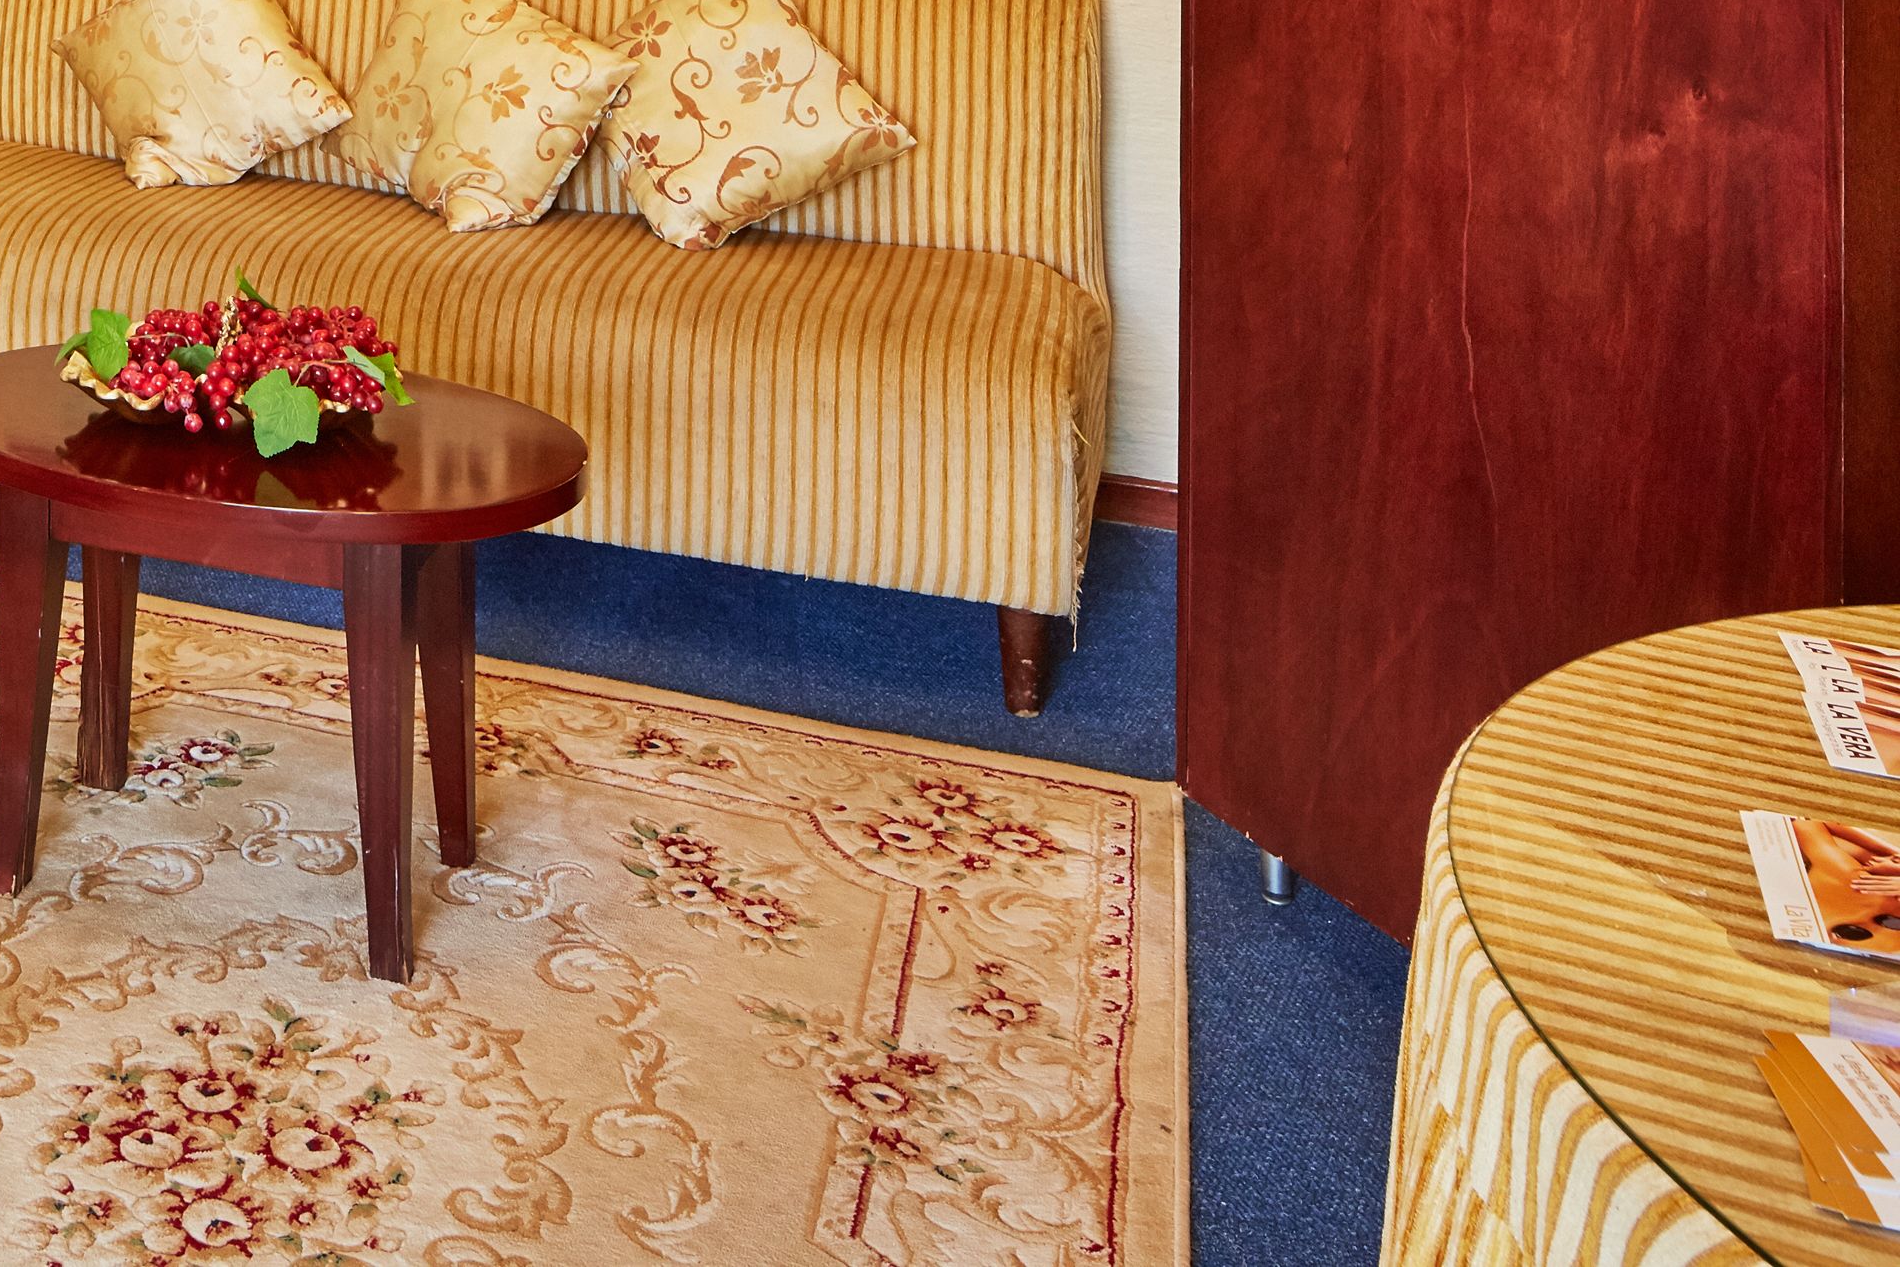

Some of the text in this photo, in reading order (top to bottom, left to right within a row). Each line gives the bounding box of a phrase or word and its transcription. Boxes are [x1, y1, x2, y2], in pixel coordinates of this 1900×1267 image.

[1831, 678, 1860, 694] LA
[1827, 703, 1877, 760] LA VERA
